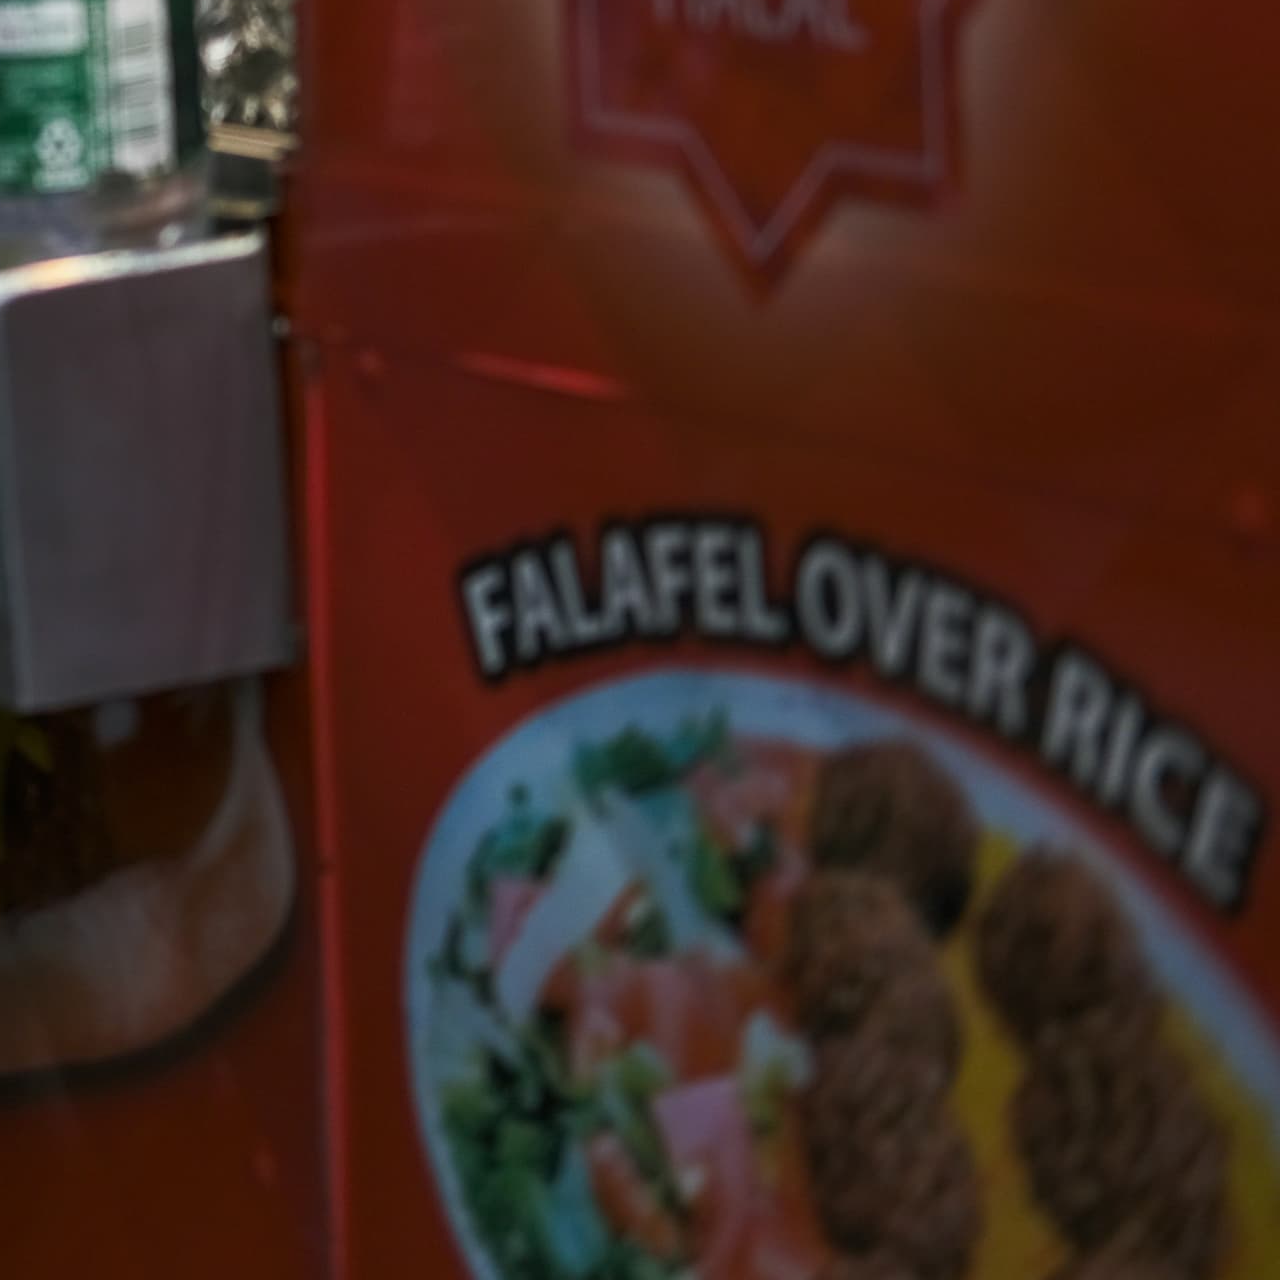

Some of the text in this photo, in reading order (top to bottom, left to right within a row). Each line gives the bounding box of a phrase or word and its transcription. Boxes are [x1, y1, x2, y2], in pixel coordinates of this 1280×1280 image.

[463, 523, 1259, 910] FALAFEL OVER RICE
